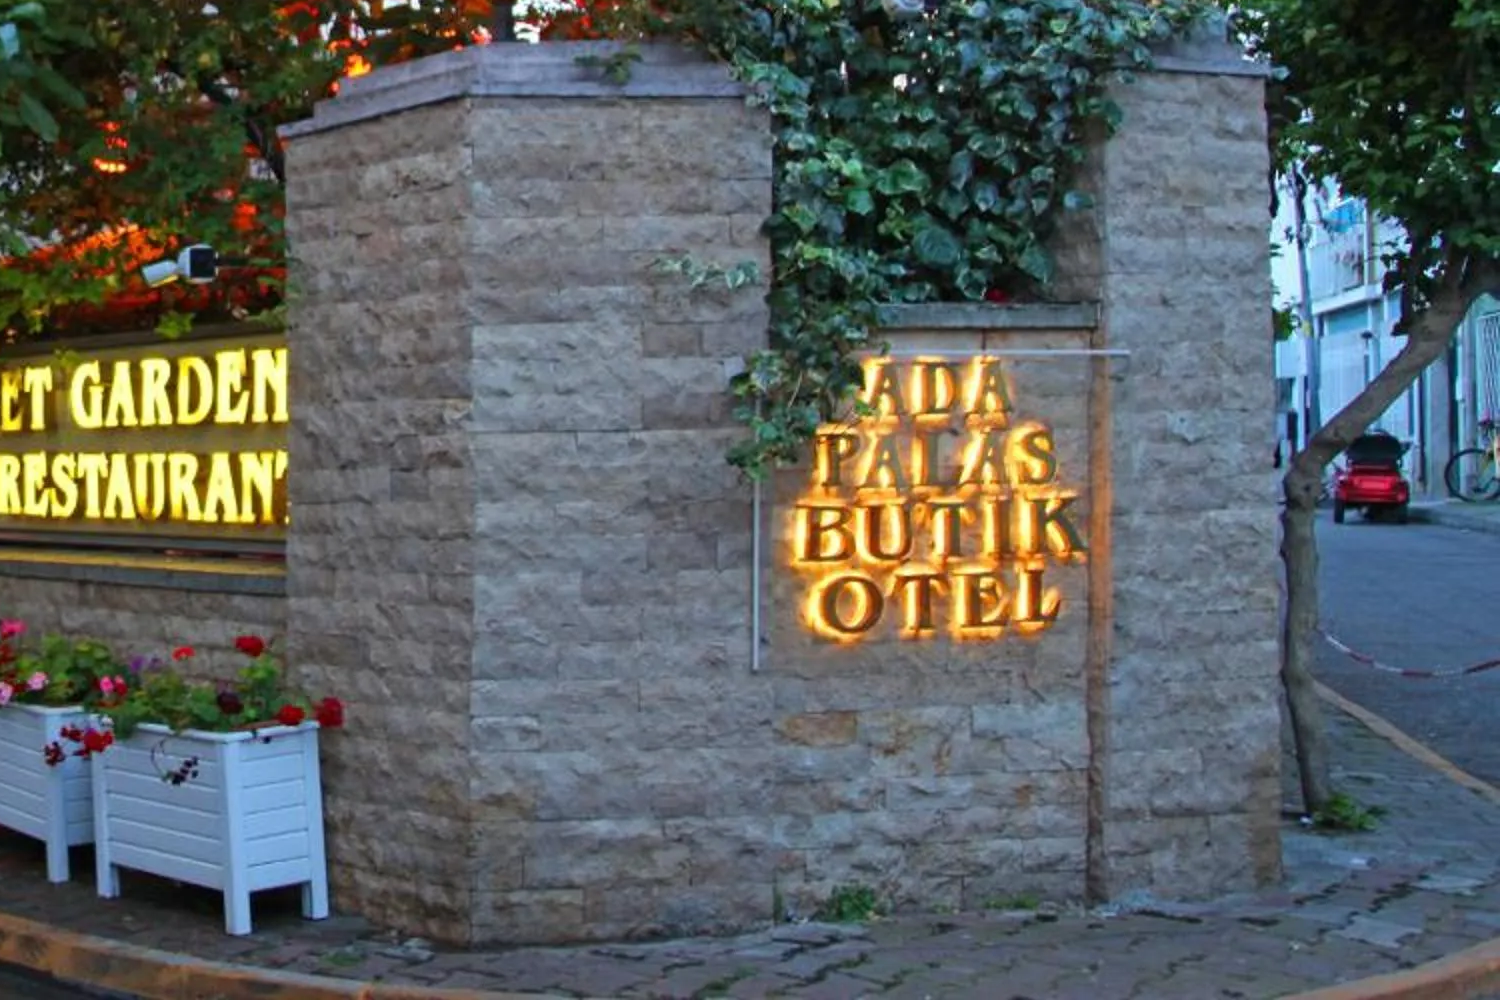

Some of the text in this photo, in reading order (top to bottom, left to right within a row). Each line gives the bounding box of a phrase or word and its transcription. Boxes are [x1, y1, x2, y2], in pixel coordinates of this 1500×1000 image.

[70, 348, 288, 429] GARDEN
[860, 356, 1014, 425] ADA
[812, 424, 1059, 494] PALAS
[791, 491, 1087, 565] BUTIK
[806, 562, 1061, 640] OTEL
